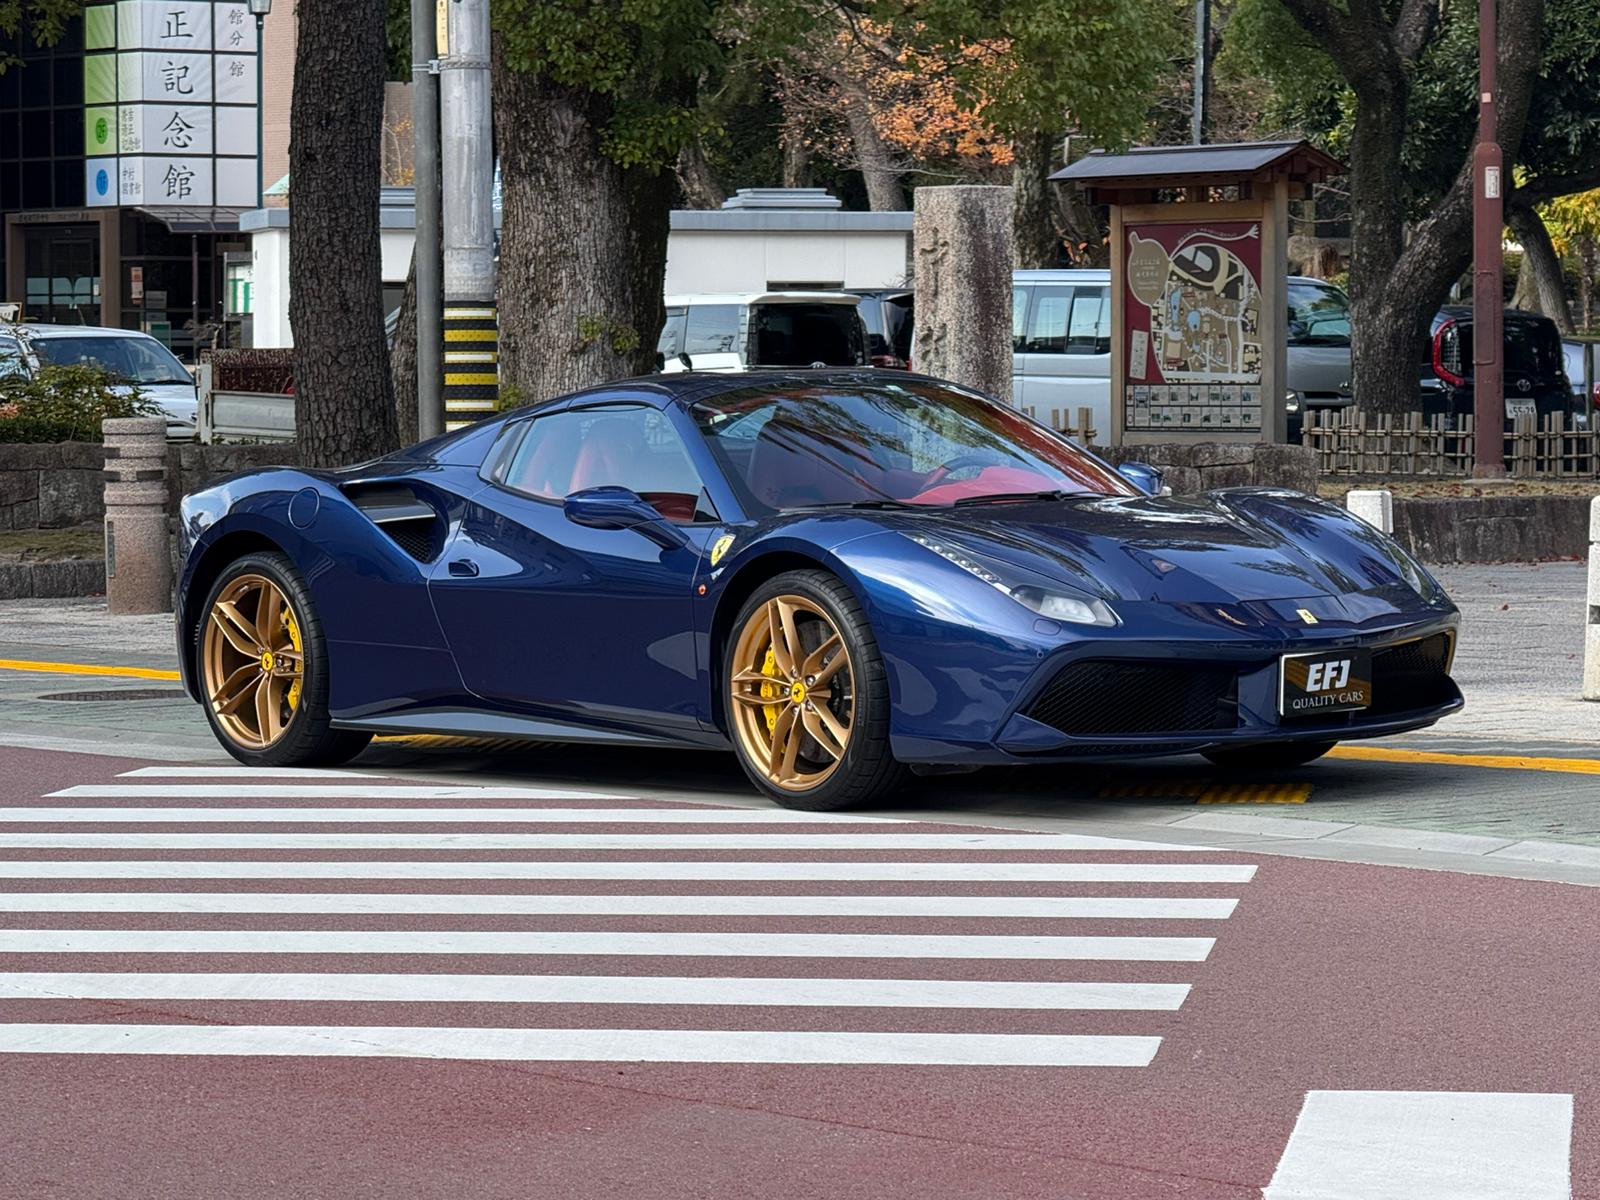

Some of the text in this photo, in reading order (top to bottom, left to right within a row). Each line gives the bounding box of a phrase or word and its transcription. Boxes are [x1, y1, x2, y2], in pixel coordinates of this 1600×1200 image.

[1306, 659, 1351, 692] EFJ
[1293, 690, 1364, 709] QUALITY CARS
